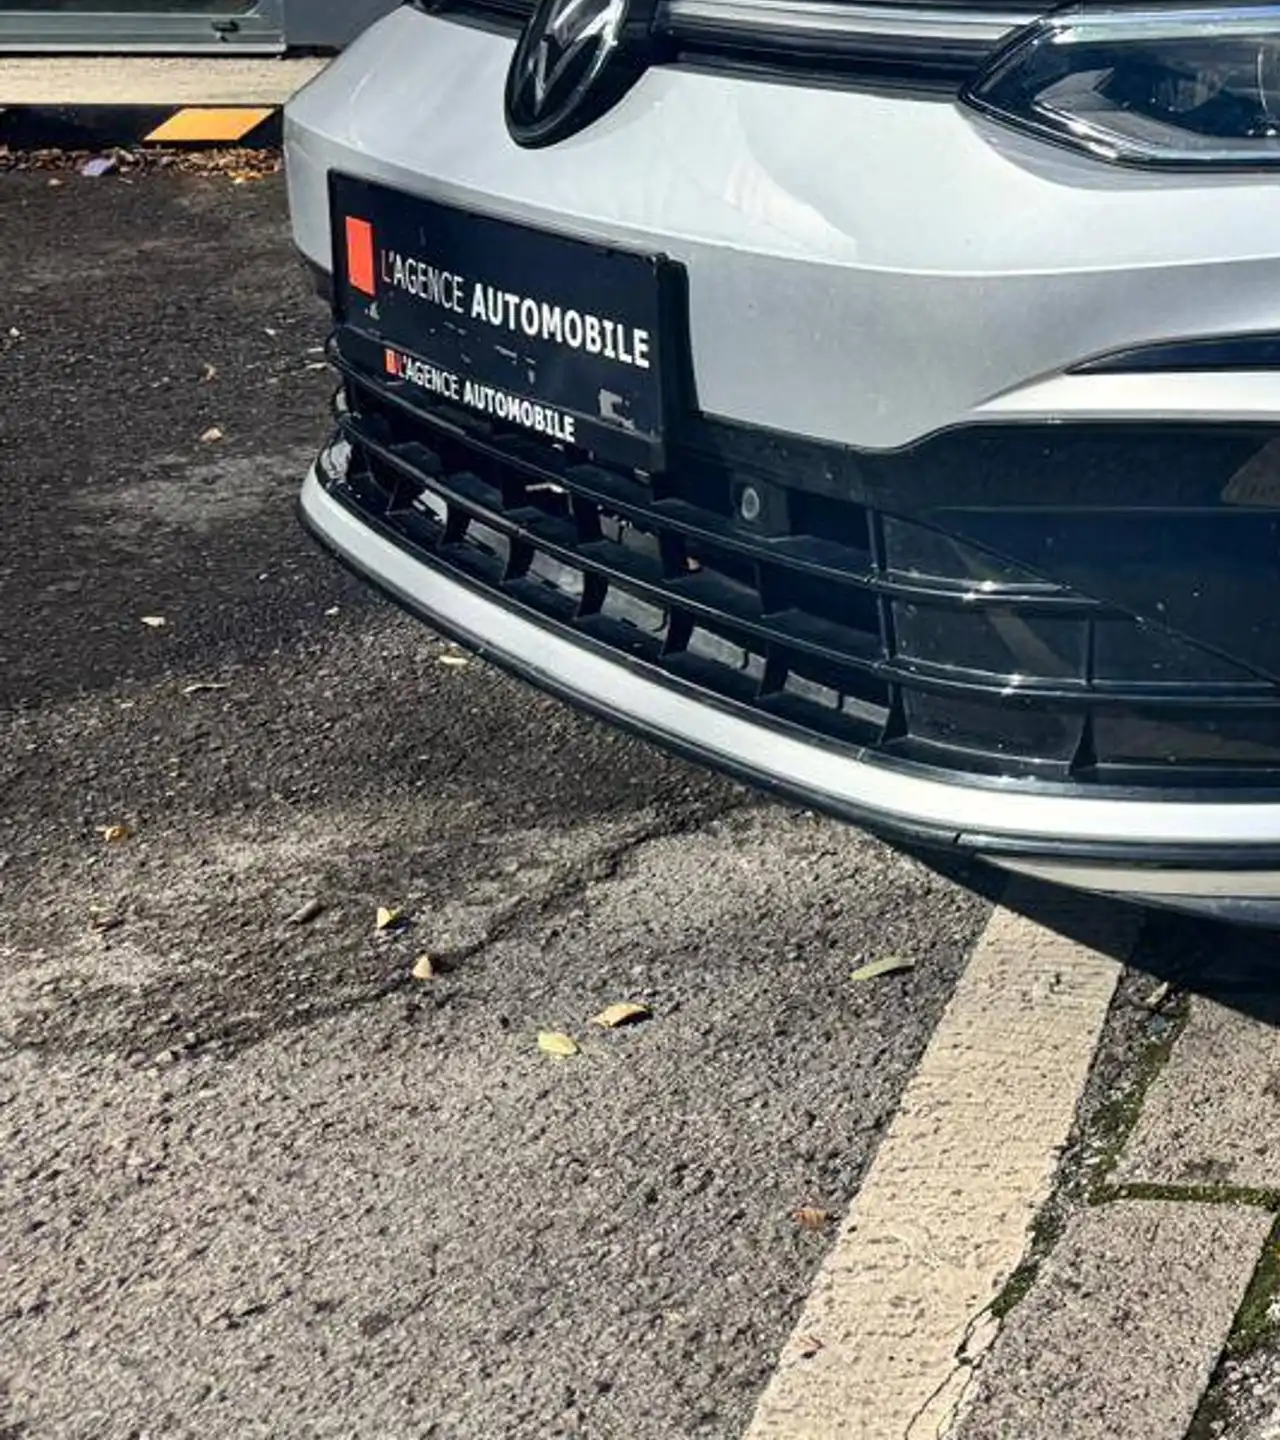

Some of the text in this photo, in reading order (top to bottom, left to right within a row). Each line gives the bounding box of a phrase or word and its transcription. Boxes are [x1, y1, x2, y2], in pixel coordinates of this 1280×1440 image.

[381, 248, 651, 369] L'AGENCE AUTOMOBILE
[463, 380, 576, 444] AUTOMOBILE
